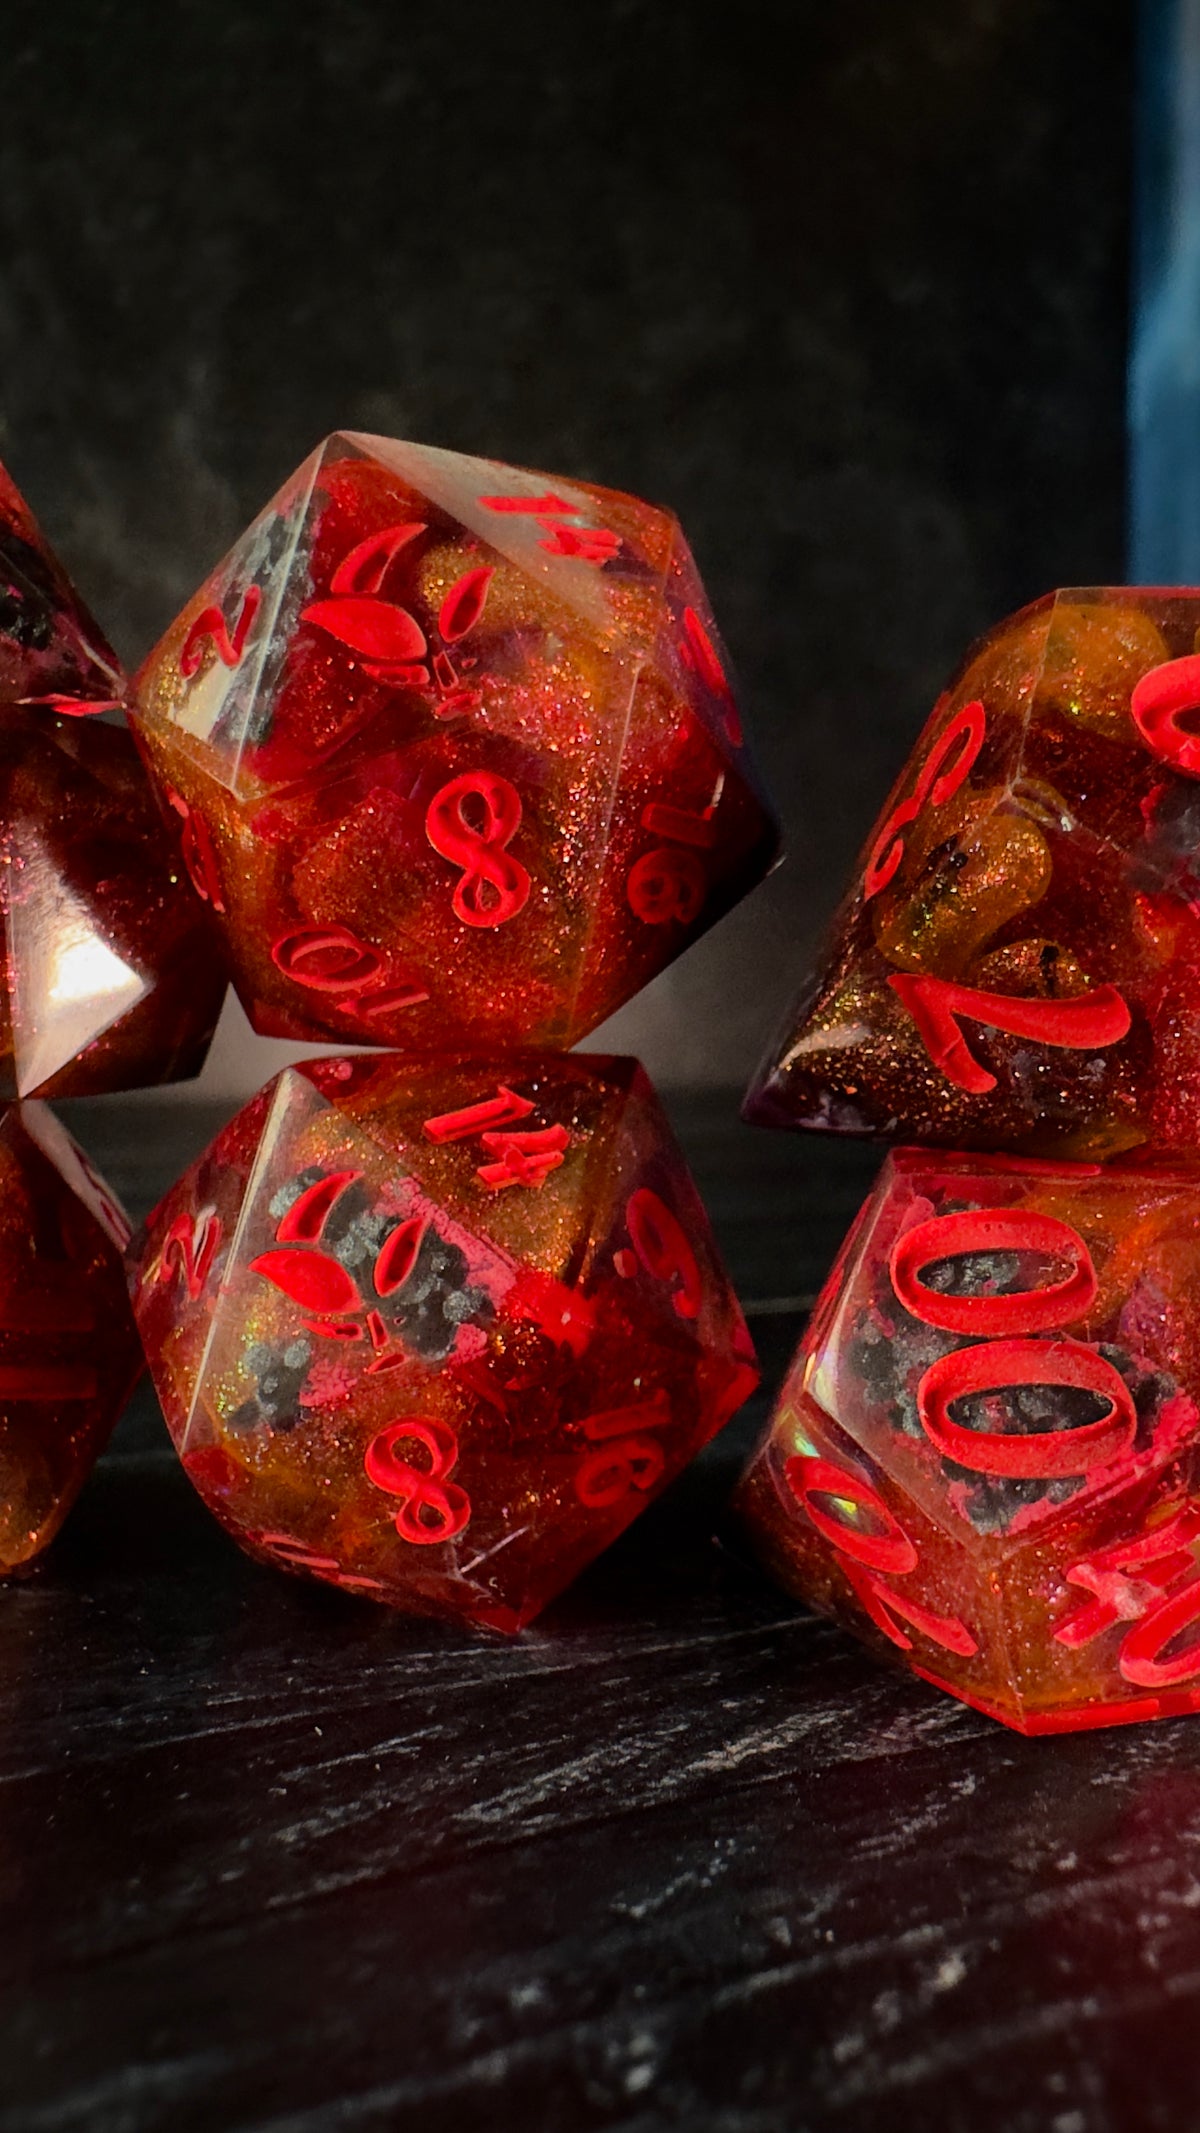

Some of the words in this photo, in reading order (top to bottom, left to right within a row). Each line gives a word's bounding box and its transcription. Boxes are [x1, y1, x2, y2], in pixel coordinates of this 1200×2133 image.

[181, 583, 260, 680] 2
[426, 769, 531, 928] 8
[421, 1085, 571, 1192] 14
[889, 1208, 1137, 1480] 00
[364, 1415, 471, 1546] 8
